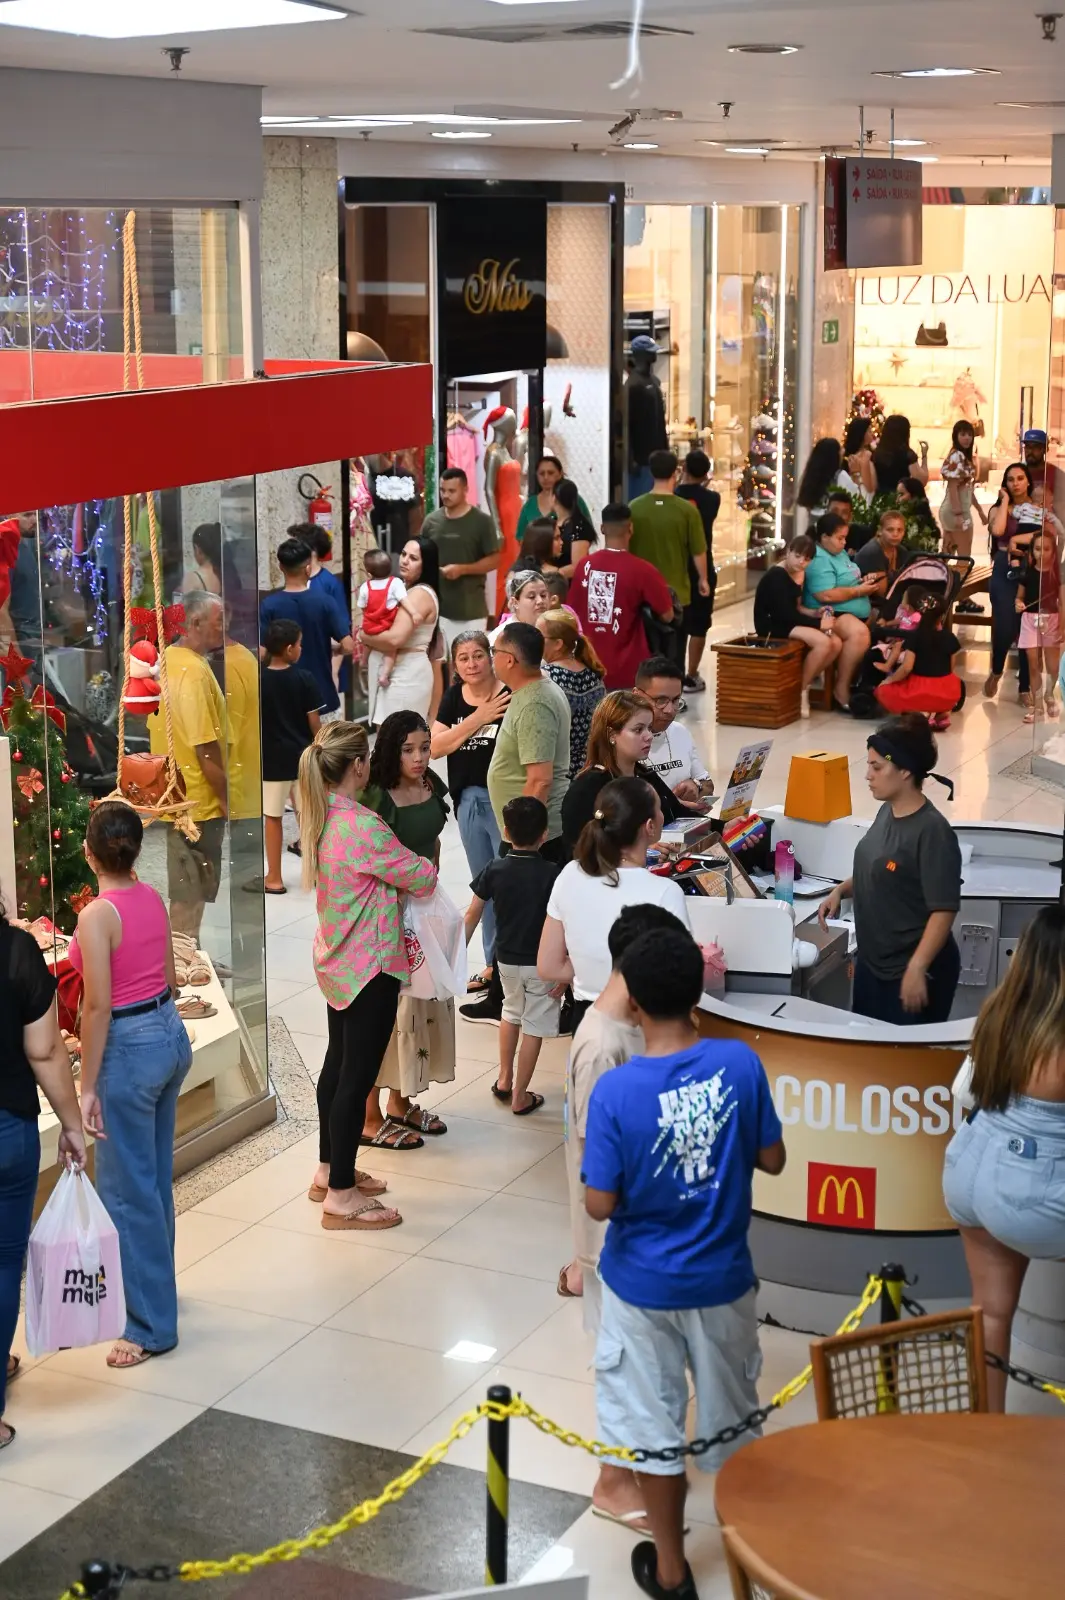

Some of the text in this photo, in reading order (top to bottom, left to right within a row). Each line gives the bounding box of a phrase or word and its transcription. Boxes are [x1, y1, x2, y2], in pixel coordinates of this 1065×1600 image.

[464, 258, 533, 314] Miss
[861, 274, 1051, 305] LUZ DA LUA
[663, 760, 683, 771] TRUE
[657, 1074, 723, 1128] JUST
[770, 1075, 965, 1136] COLOSS
[673, 1113, 717, 1156] DO
